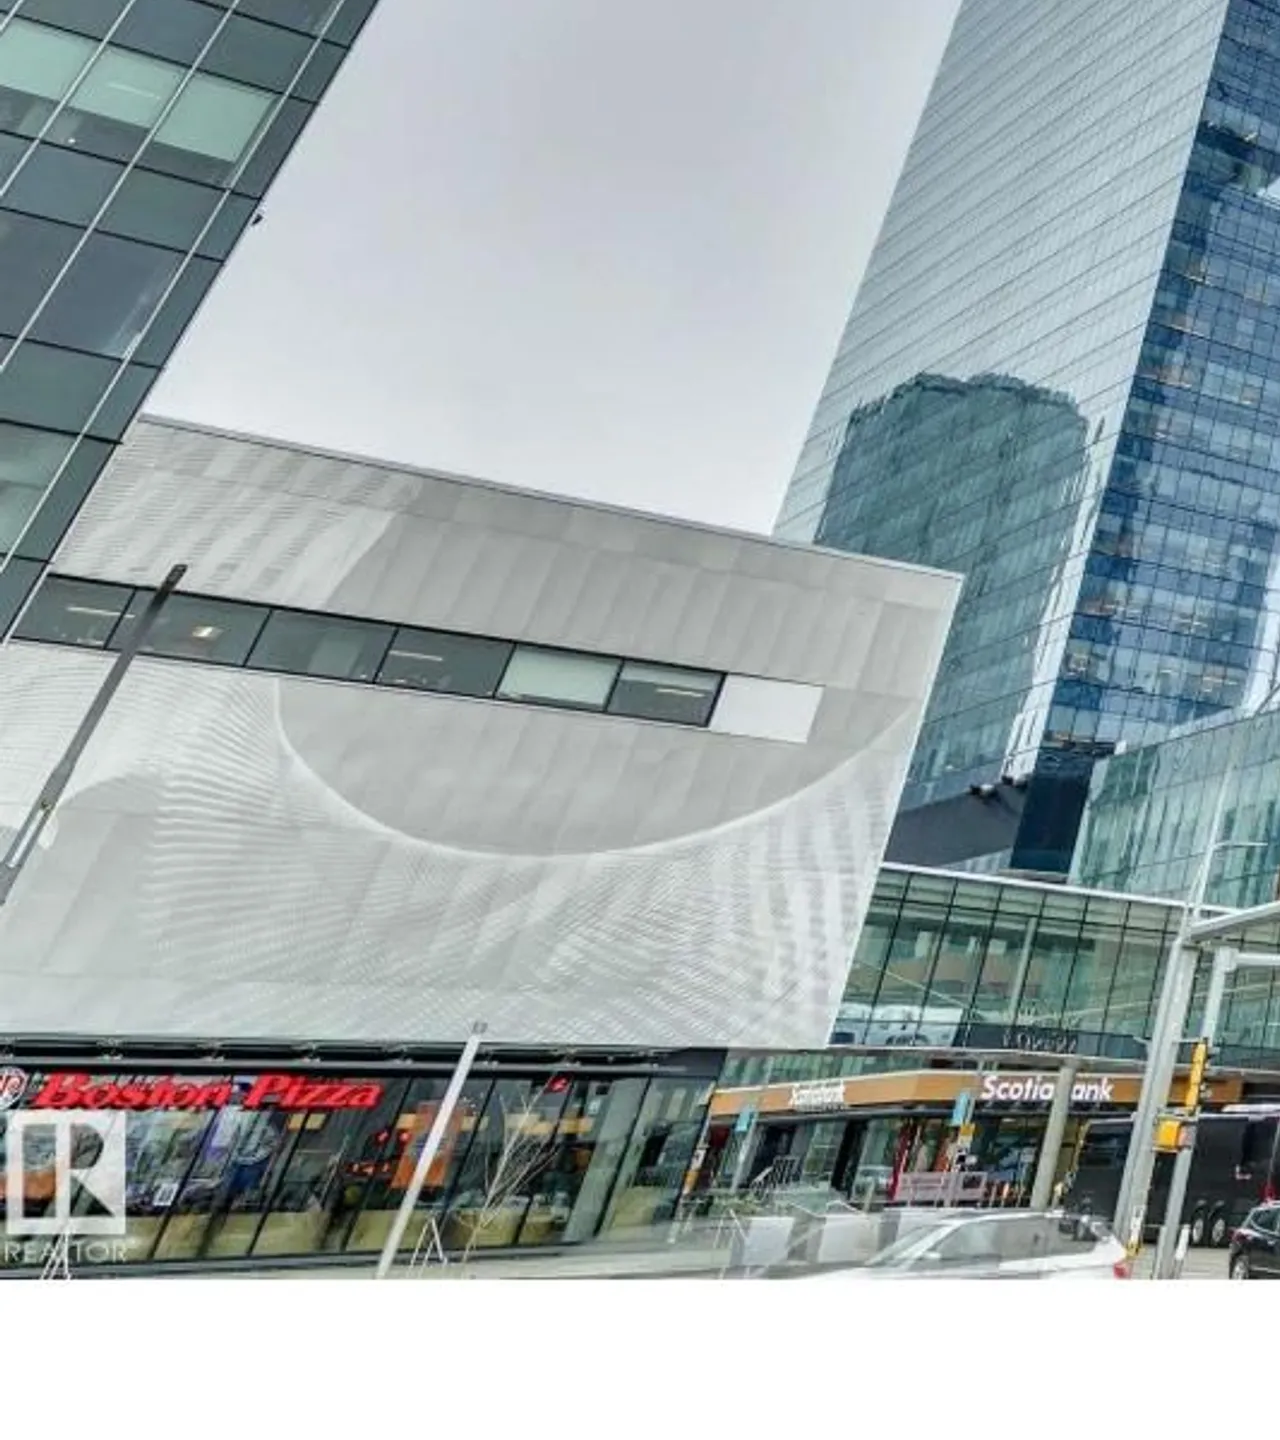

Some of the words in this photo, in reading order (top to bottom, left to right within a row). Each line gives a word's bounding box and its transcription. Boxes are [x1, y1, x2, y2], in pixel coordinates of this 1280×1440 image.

[31, 1071, 233, 1109] Boston
[243, 1072, 384, 1109] Pizza
[980, 1075, 1116, 1102] Scotiaank
